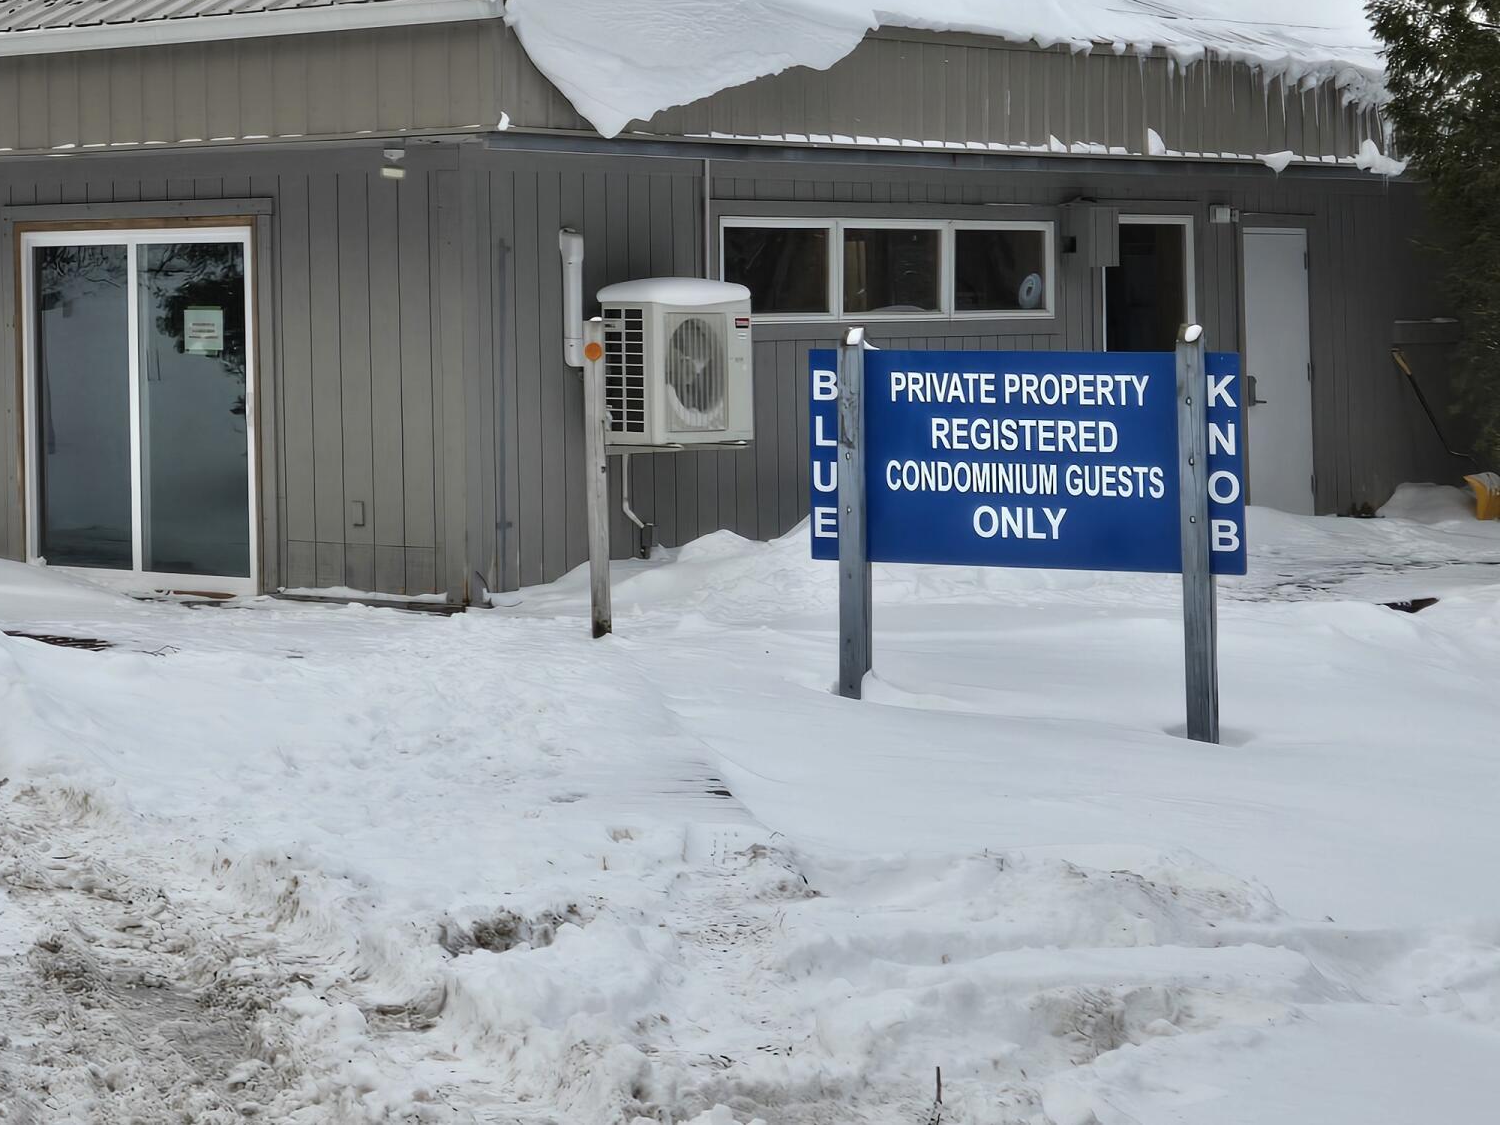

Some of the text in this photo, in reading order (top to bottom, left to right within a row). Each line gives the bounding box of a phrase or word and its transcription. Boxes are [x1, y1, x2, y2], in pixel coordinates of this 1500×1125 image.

[890, 371, 1149, 407] PRIVATE PROPERTY
[812, 370, 838, 538] BLUE
[931, 418, 1118, 453] REGISTERED
[886, 459, 1165, 499] CONDOMINIUM GUESTS
[1207, 374, 1241, 553] KNOB
[973, 506, 1067, 540] ONLY
